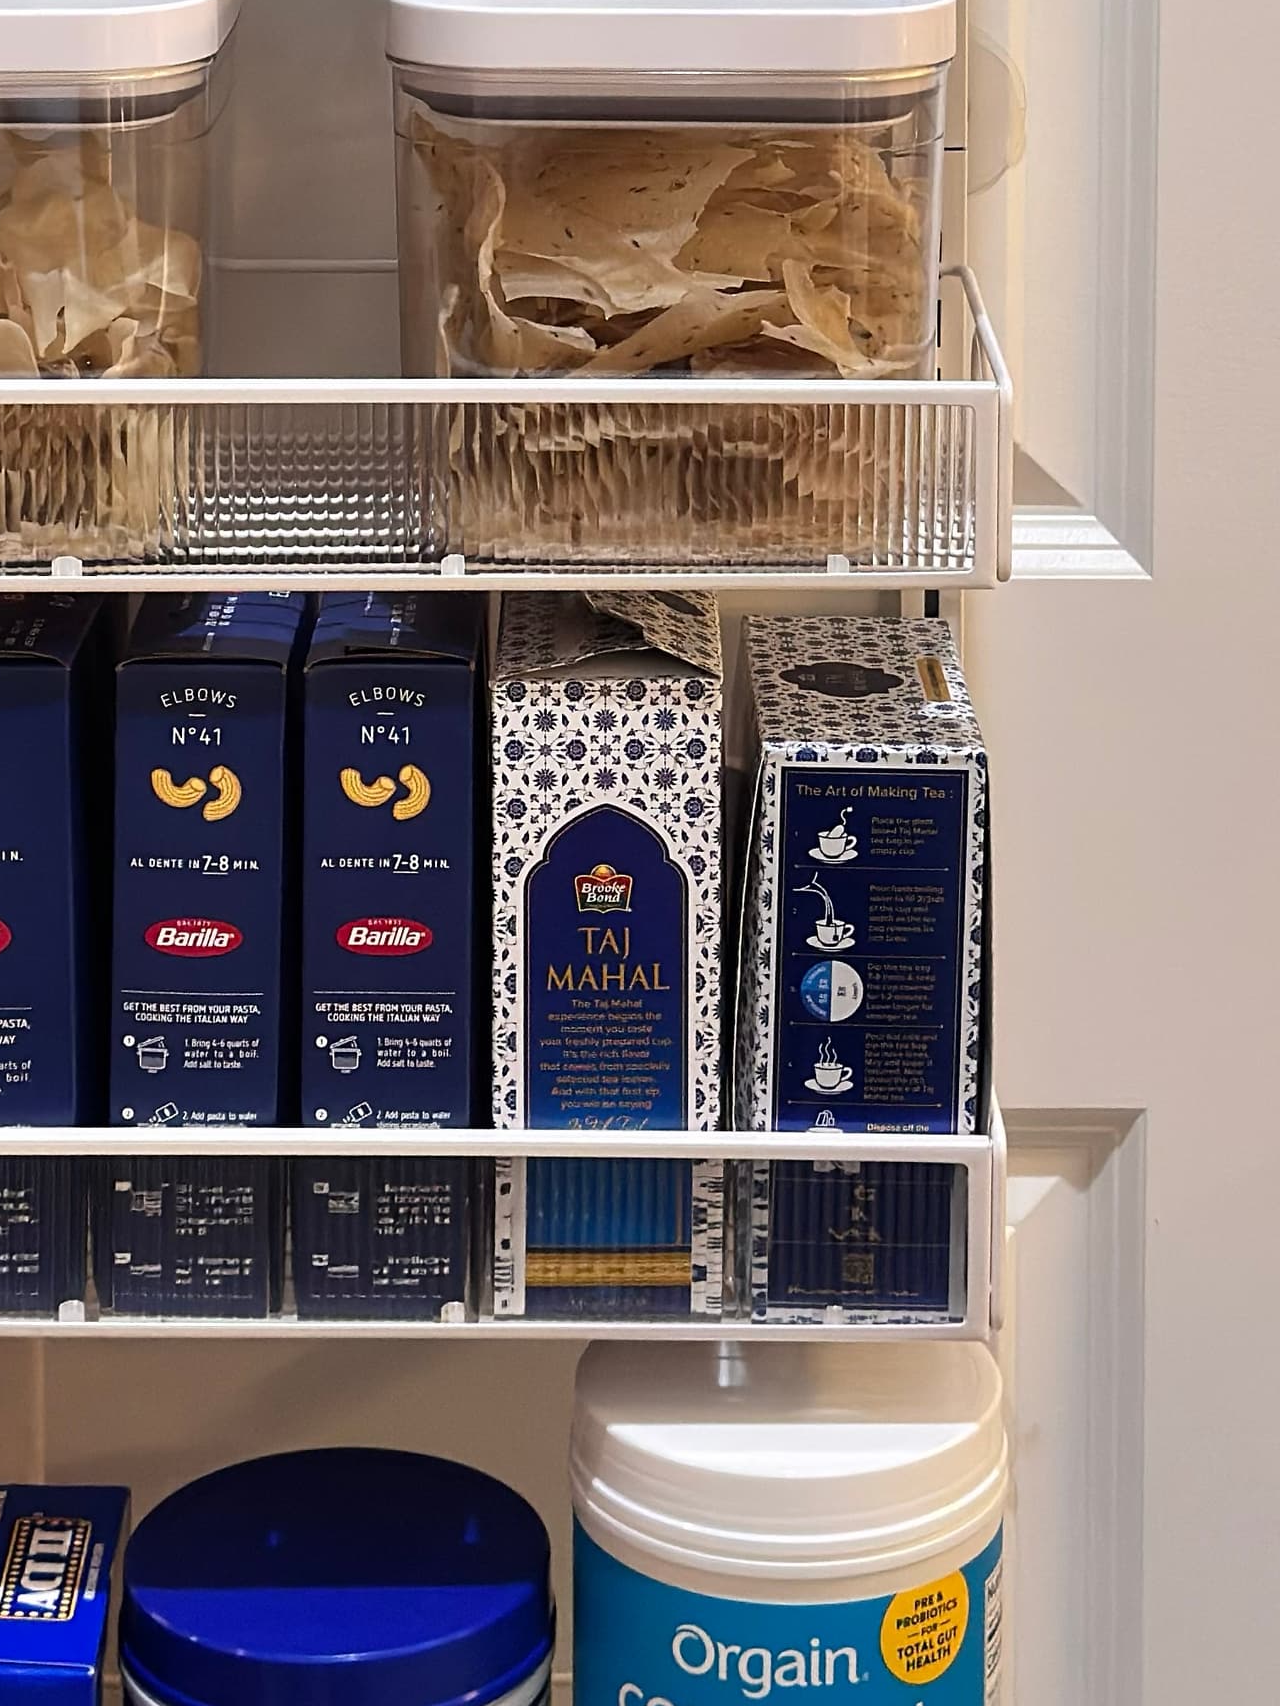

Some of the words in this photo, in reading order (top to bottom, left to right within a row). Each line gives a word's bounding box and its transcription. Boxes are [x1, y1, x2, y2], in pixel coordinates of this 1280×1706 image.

[161, 688, 237, 709] ELBOWS
[349, 686, 426, 707] ELBOWS
[172, 727, 221, 746] N°41
[361, 725, 410, 745] N°41
[796, 784, 822, 797] The
[826, 785, 847, 797] Art
[851, 785, 864, 797] of
[867, 785, 918, 800] Making
[922, 787, 945, 800] Tea
[582, 882, 625, 895] Brooke
[586, 892, 621, 904] Bond
[156, 927, 228, 947] Barilla
[348, 927, 420, 946] Barilla
[577, 927, 630, 960] TAJ
[547, 963, 670, 991] MAHAL
[913, 1594, 935, 1611] PRE
[935, 1591, 943, 1604] &
[896, 1597, 958, 1629] PROBIOTICS
[921, 1623, 938, 1636] FOR
[898, 1637, 936, 1660] TOTAL
[937, 1627, 957, 1648] GUT
[672, 1624, 859, 1699] Orgain
[906, 1645, 951, 1672] HEALTH
